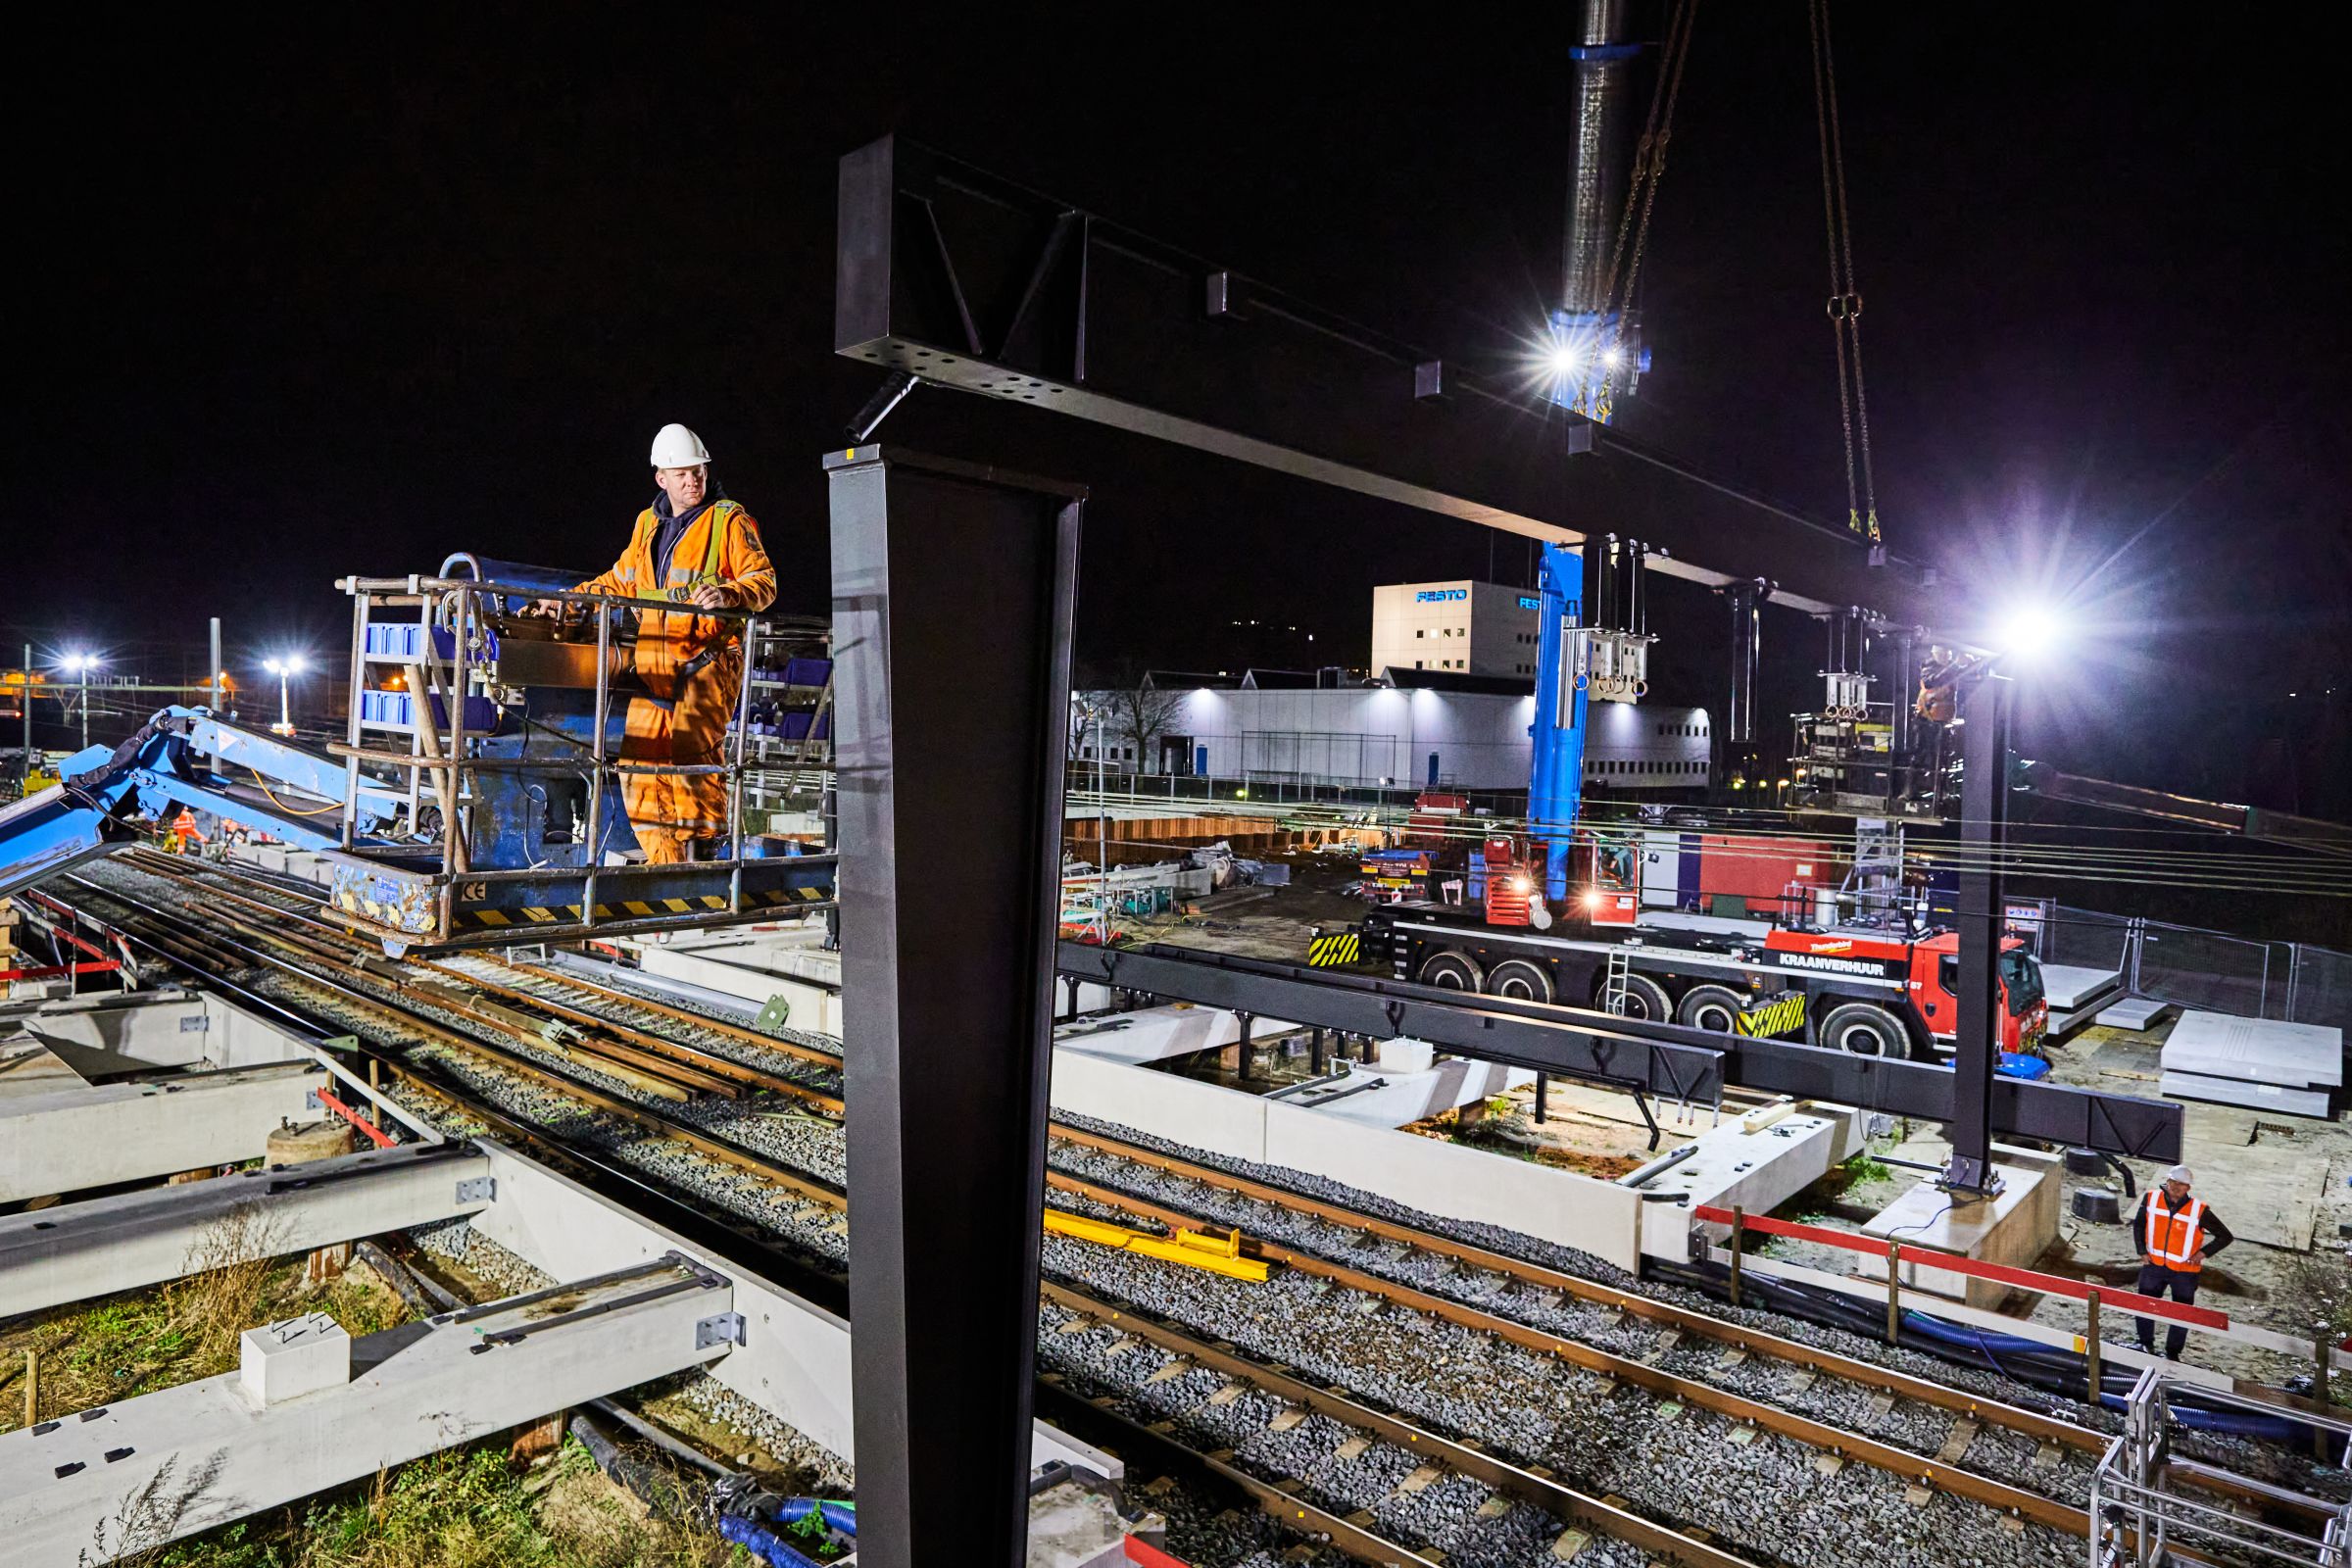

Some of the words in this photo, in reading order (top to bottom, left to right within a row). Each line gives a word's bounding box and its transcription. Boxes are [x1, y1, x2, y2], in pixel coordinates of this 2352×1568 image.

[1416, 590, 1467, 603] FESTO
[464, 882, 484, 900] CE
[1780, 953, 1884, 976] KRAANVERHUUR
